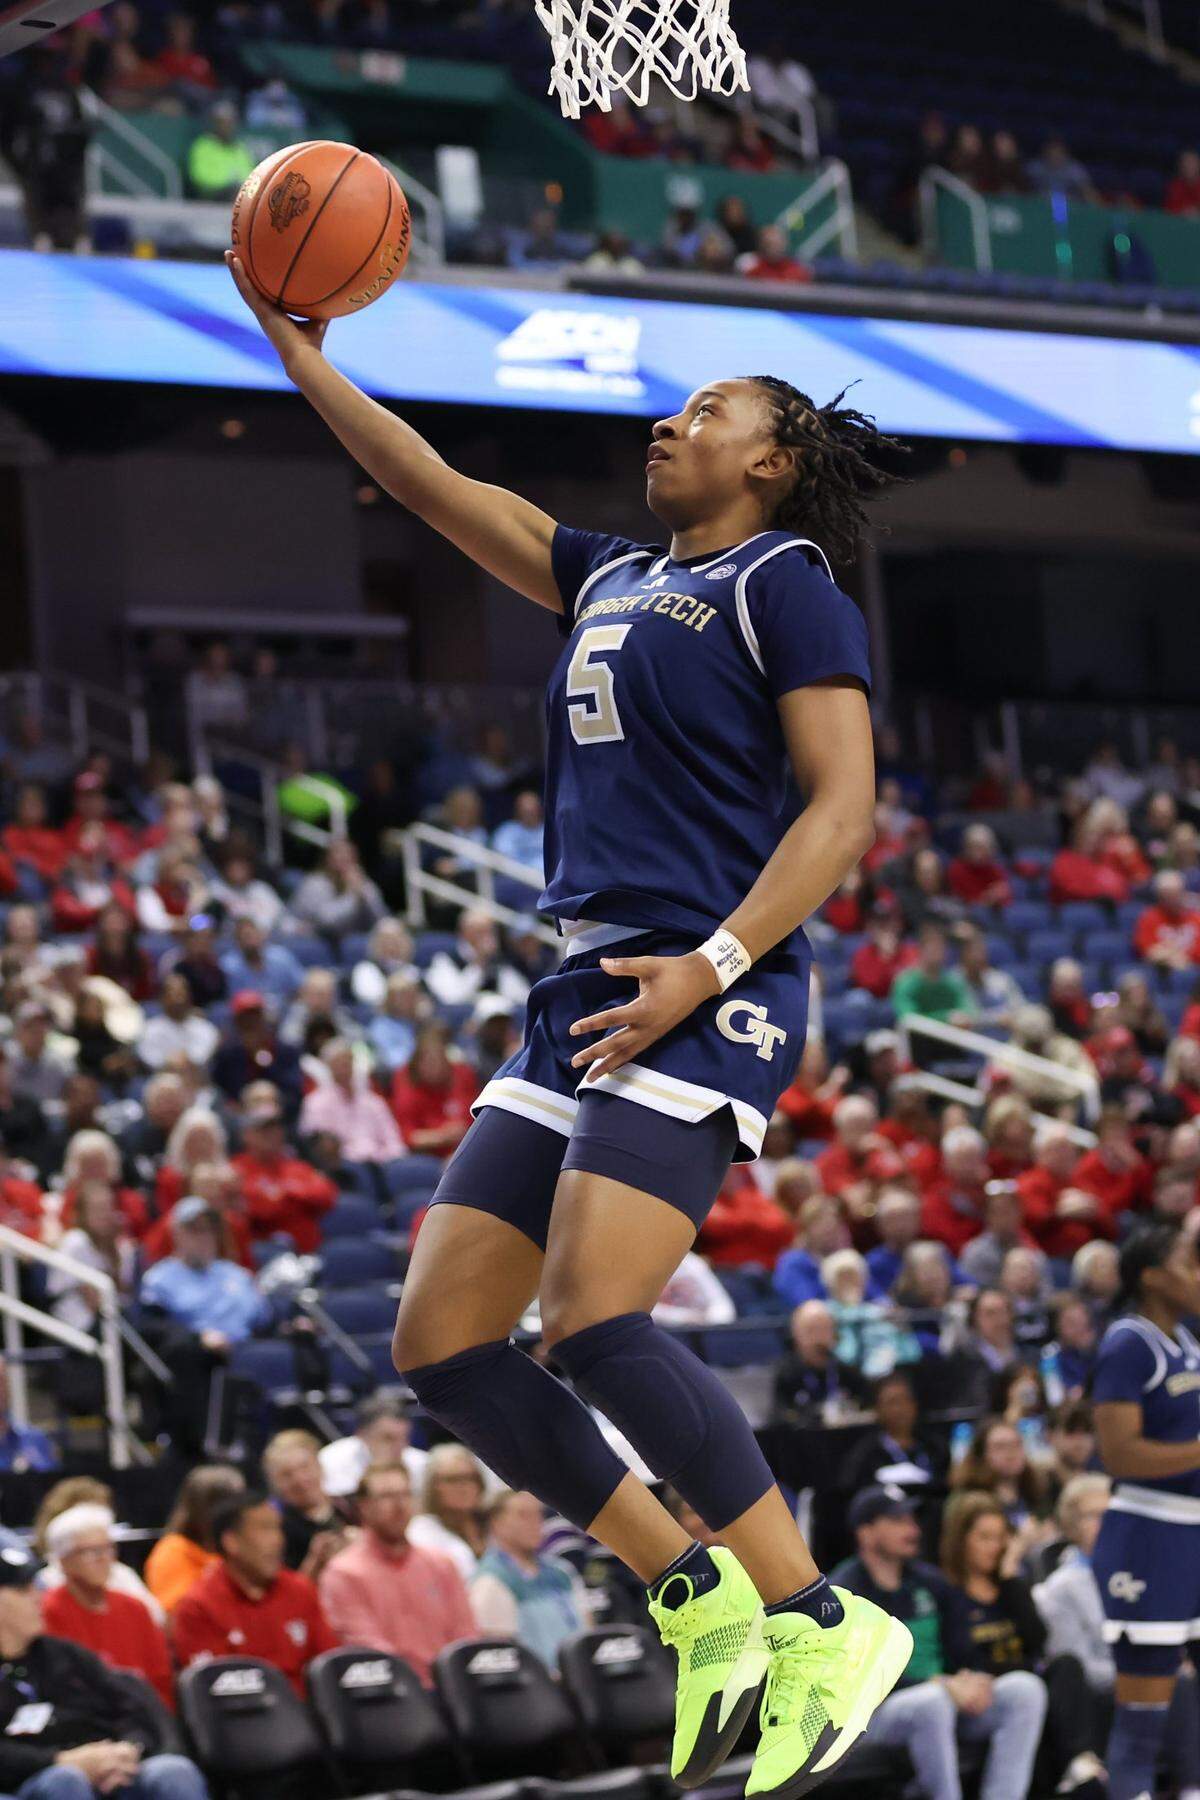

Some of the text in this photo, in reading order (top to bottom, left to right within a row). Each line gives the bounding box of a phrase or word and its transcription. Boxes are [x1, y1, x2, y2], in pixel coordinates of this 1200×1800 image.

[640, 592, 718, 633] TECH
[566, 623, 634, 745] 5
[715, 999, 787, 1062] GT
